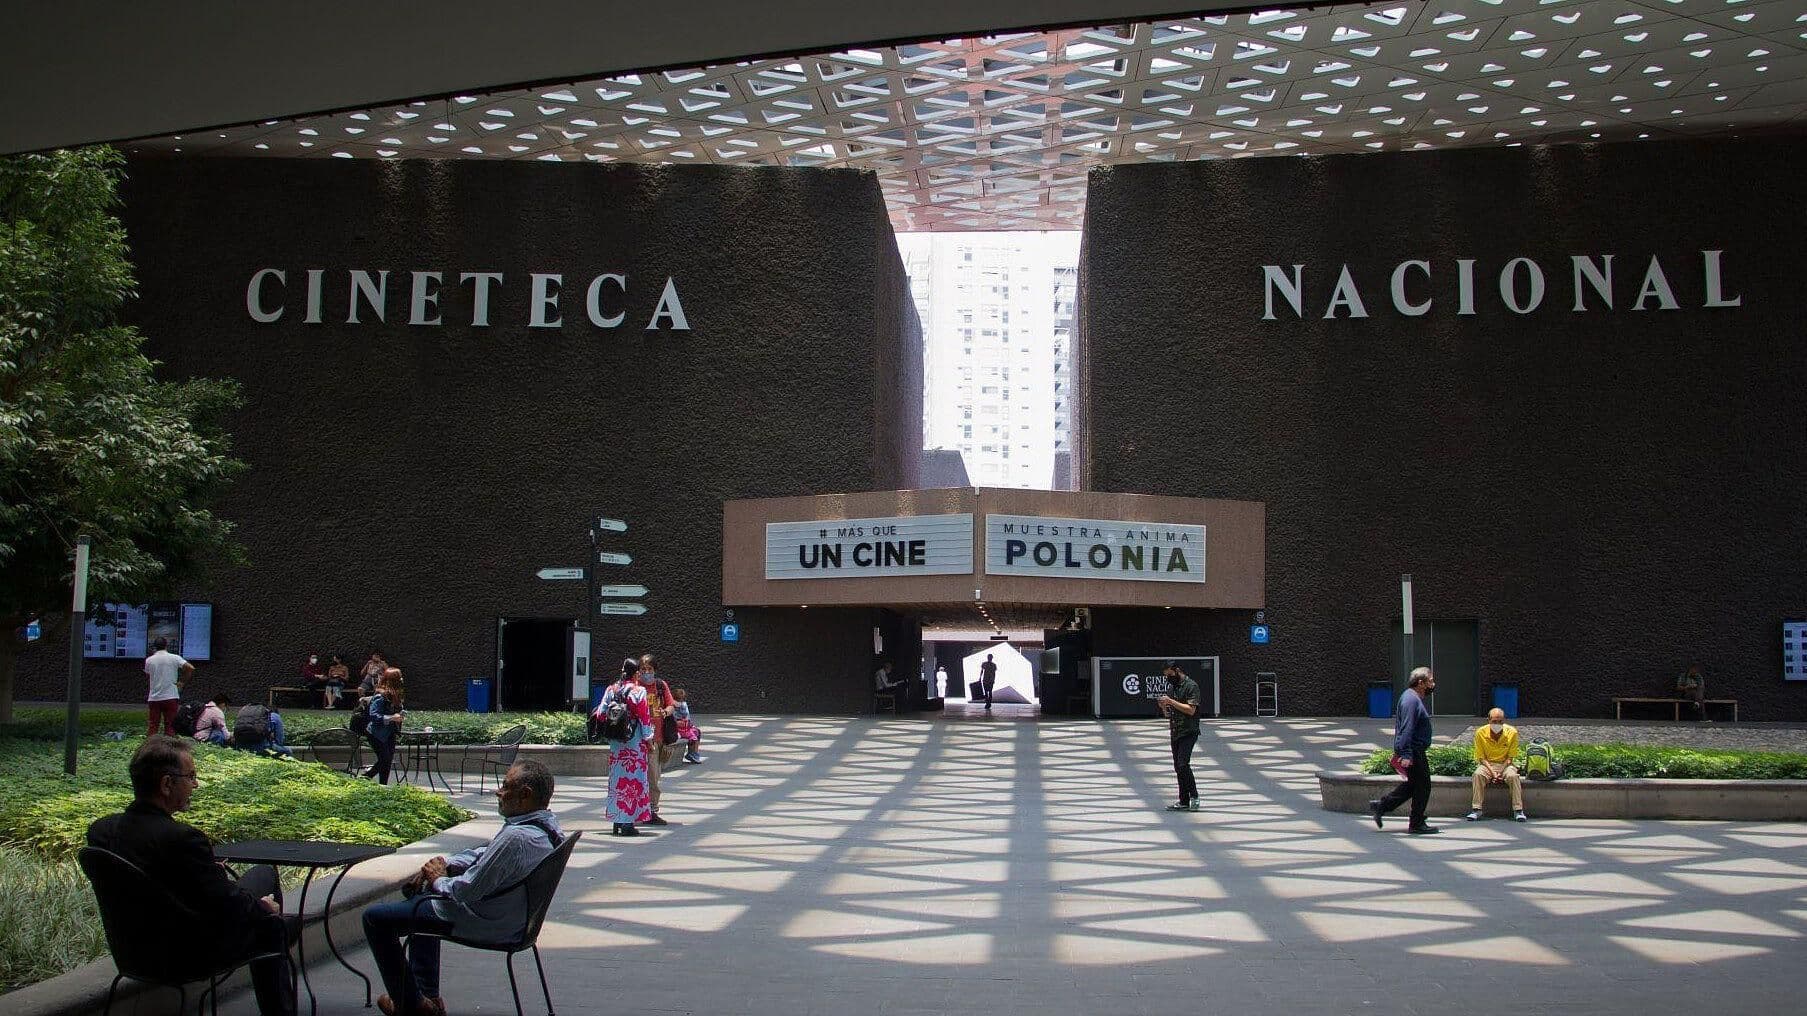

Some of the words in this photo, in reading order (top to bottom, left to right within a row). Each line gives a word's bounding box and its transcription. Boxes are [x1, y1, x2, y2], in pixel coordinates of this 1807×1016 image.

[246, 268, 691, 330] CINETECA
[1260, 250, 1741, 320] NACIONAL
[872, 525, 897, 536] QUE
[1003, 523, 1102, 538] MUESTRA
[1126, 530, 1189, 544] ANIMA
[799, 543, 842, 569] UN
[852, 539, 926, 568] CINE
[1005, 539, 1190, 572] POLONIA
[1145, 675, 1168, 685] CINE
